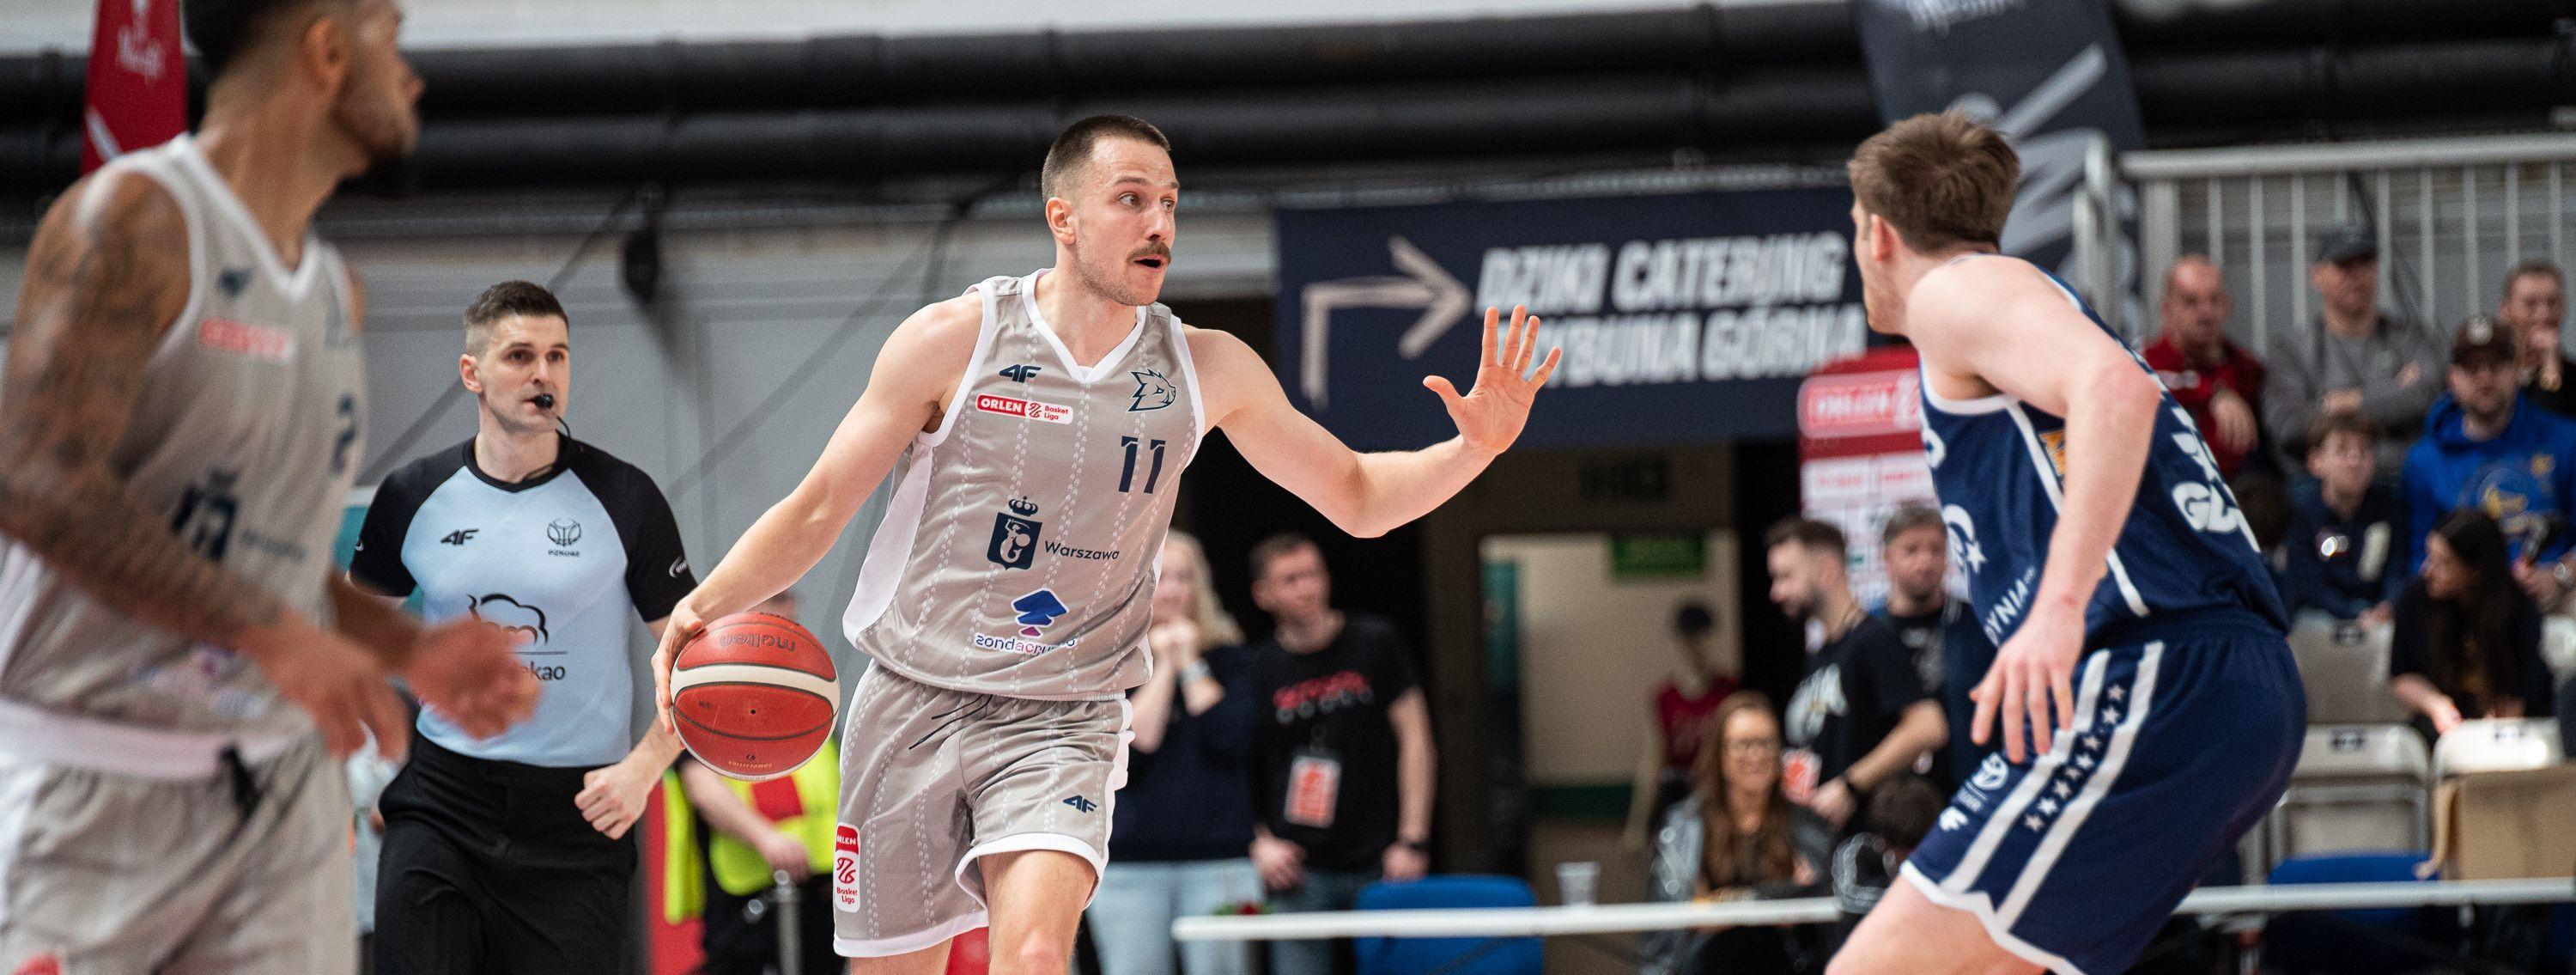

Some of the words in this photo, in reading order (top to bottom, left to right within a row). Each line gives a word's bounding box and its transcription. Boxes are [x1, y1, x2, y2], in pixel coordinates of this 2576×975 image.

[1476, 245, 1608, 314] DZIKI
[1613, 232, 1847, 310] CATERING
[1498, 313, 1701, 387] YBUNA
[999, 364, 1042, 382] 4F
[981, 398, 1022, 412] ORLEN
[1044, 405, 1068, 414] Basket
[1118, 436, 1166, 494] 11
[440, 528, 478, 545] 4F
[1044, 540, 1120, 559] Warszawa
[1984, 578, 2028, 646] DYNIA
[720, 632, 796, 652] molten
[520, 661, 566, 680] ekao
[1063, 795, 1097, 814] 4F
[841, 895, 855, 905] Liga
